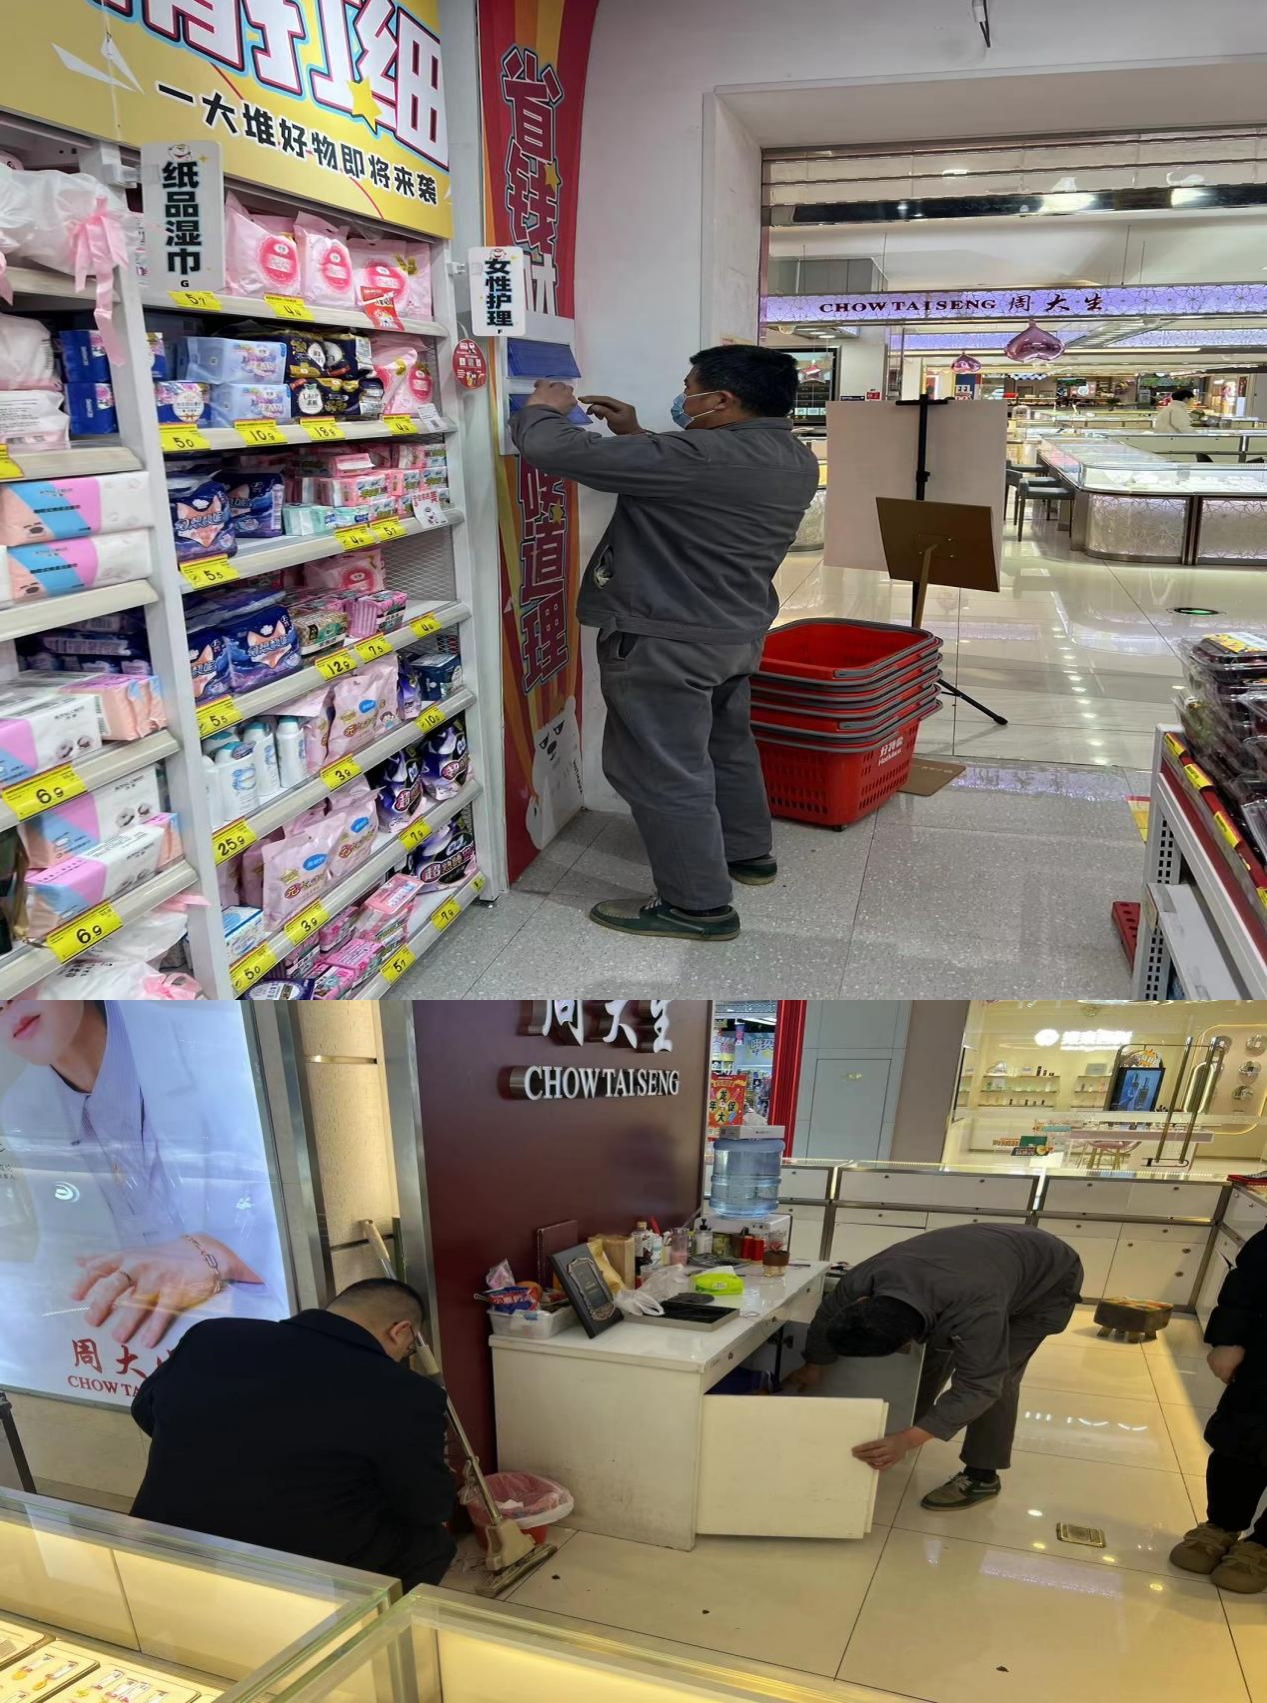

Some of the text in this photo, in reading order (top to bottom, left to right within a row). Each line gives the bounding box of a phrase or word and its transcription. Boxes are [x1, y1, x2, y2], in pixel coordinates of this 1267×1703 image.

[158, 83, 438, 206] 一大堆好物即将来袭
[162, 161, 202, 277] 纸品湿巾
[181, 279, 190, 288] G
[484, 258, 514, 327] 女性护理
[819, 301, 887, 313] CHOW
[1008, 292, 1103, 312] 周大生
[524, 1065, 600, 1101] CHOW
[67, 1375, 118, 1395] CHOW
